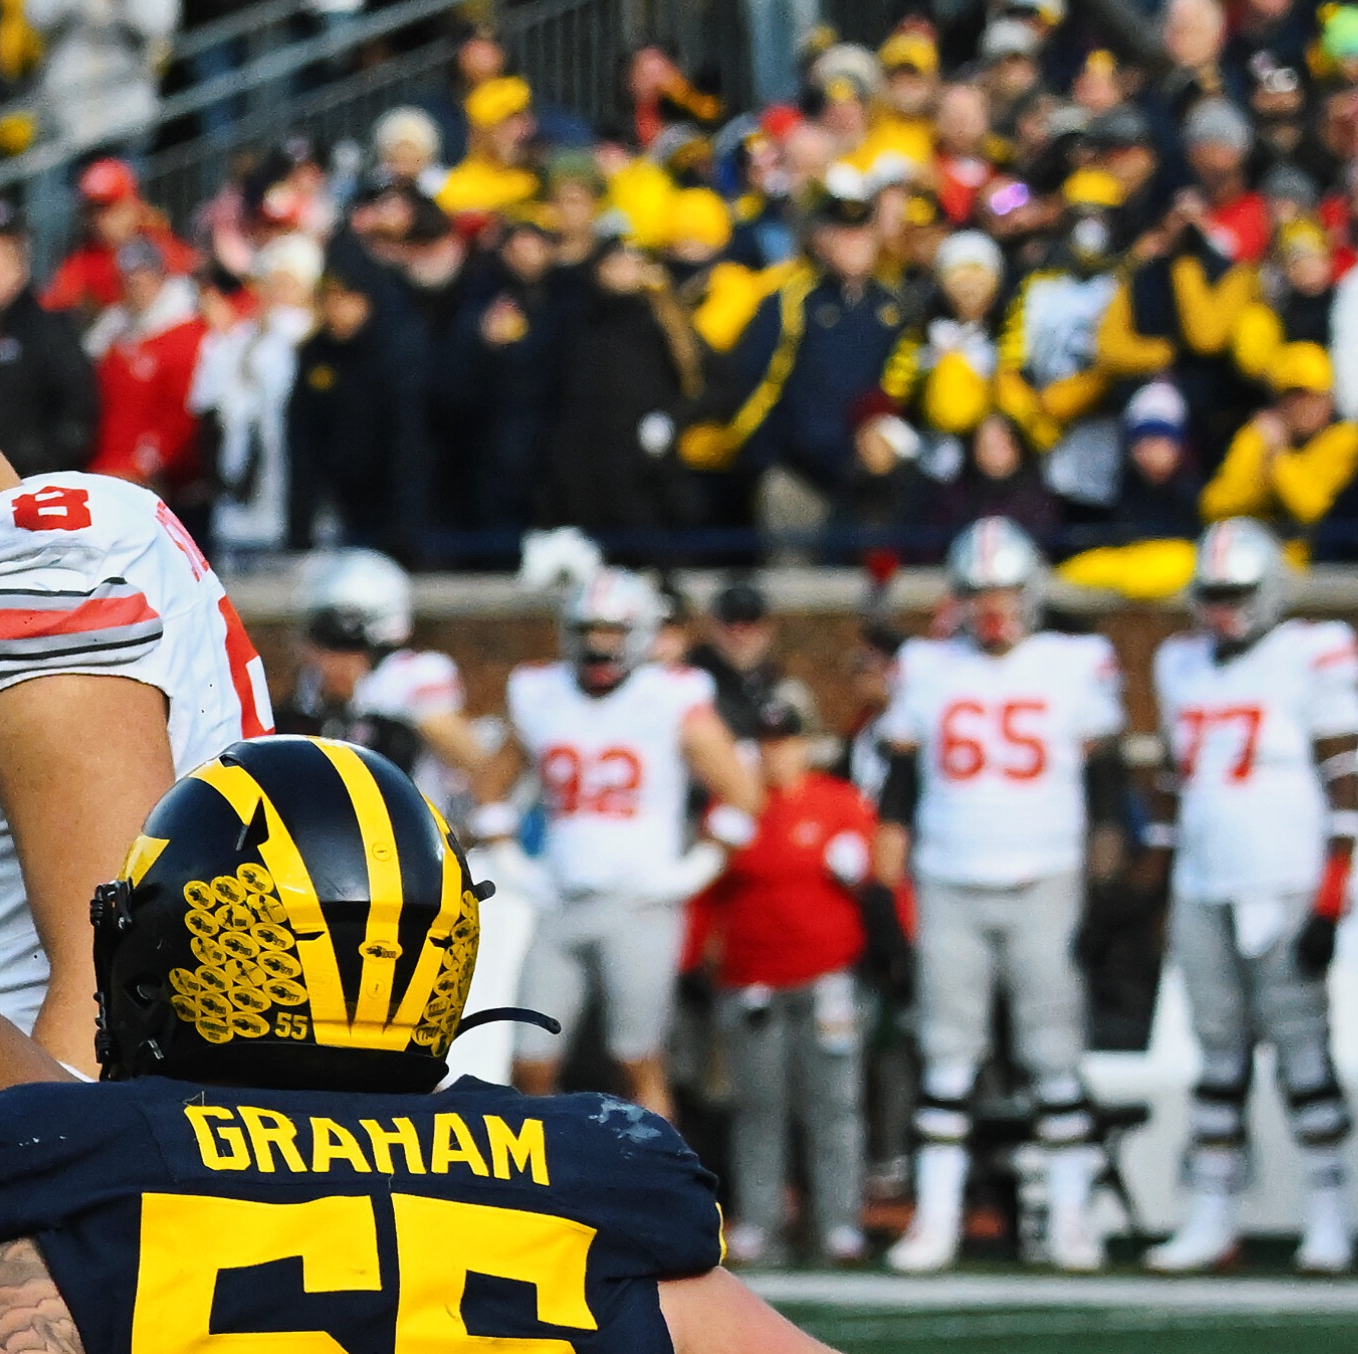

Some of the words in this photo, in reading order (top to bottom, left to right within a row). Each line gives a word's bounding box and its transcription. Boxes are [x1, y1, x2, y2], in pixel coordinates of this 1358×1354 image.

[11, 485, 92, 532] 8
[937, 698, 1049, 783] 65
[1178, 703, 1263, 785] 77
[274, 1011, 309, 1041] 55
[185, 1104, 550, 1187] GRAHAM
